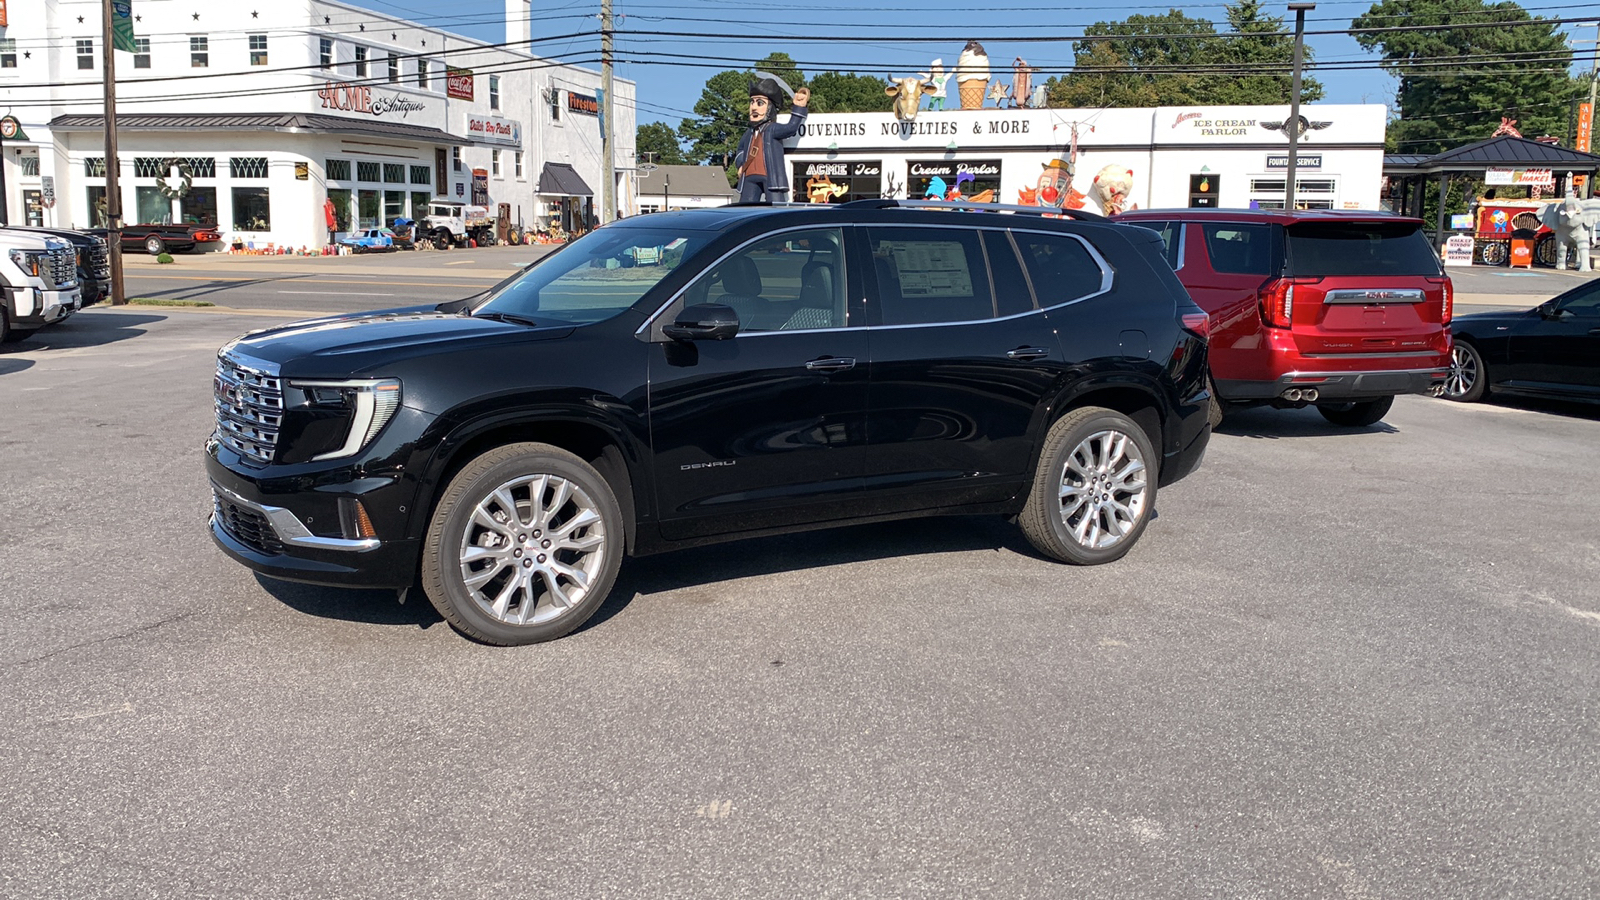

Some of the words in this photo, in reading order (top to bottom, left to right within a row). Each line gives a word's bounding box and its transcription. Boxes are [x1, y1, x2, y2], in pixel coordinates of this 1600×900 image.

[318, 80, 372, 114] ACME
[384, 93, 425, 118] Antiques
[569, 92, 598, 111] Fireston
[470, 119, 484, 132] Dutch
[486, 121, 495, 135] Boy
[496, 122, 511, 136] Paints
[1193, 119, 1212, 127] ICE
[1215, 119, 1257, 127] CREAM
[1580, 105, 1589, 138] ACME
[791, 122, 866, 138] OUVENIRS
[881, 121, 958, 136] NOVELTIES
[972, 121, 983, 135] &
[988, 120, 1030, 134] MORE
[1201, 128, 1247, 136] PARLOR
[1296, 157, 1320, 166] SERVICE
[806, 163, 848, 176] ACME
[855, 163, 880, 176] Ice
[910, 163, 951, 176] Cream
[956, 163, 999, 176] Parlor
[44, 188, 54, 197] 25
[680, 460, 736, 470] DENALI
